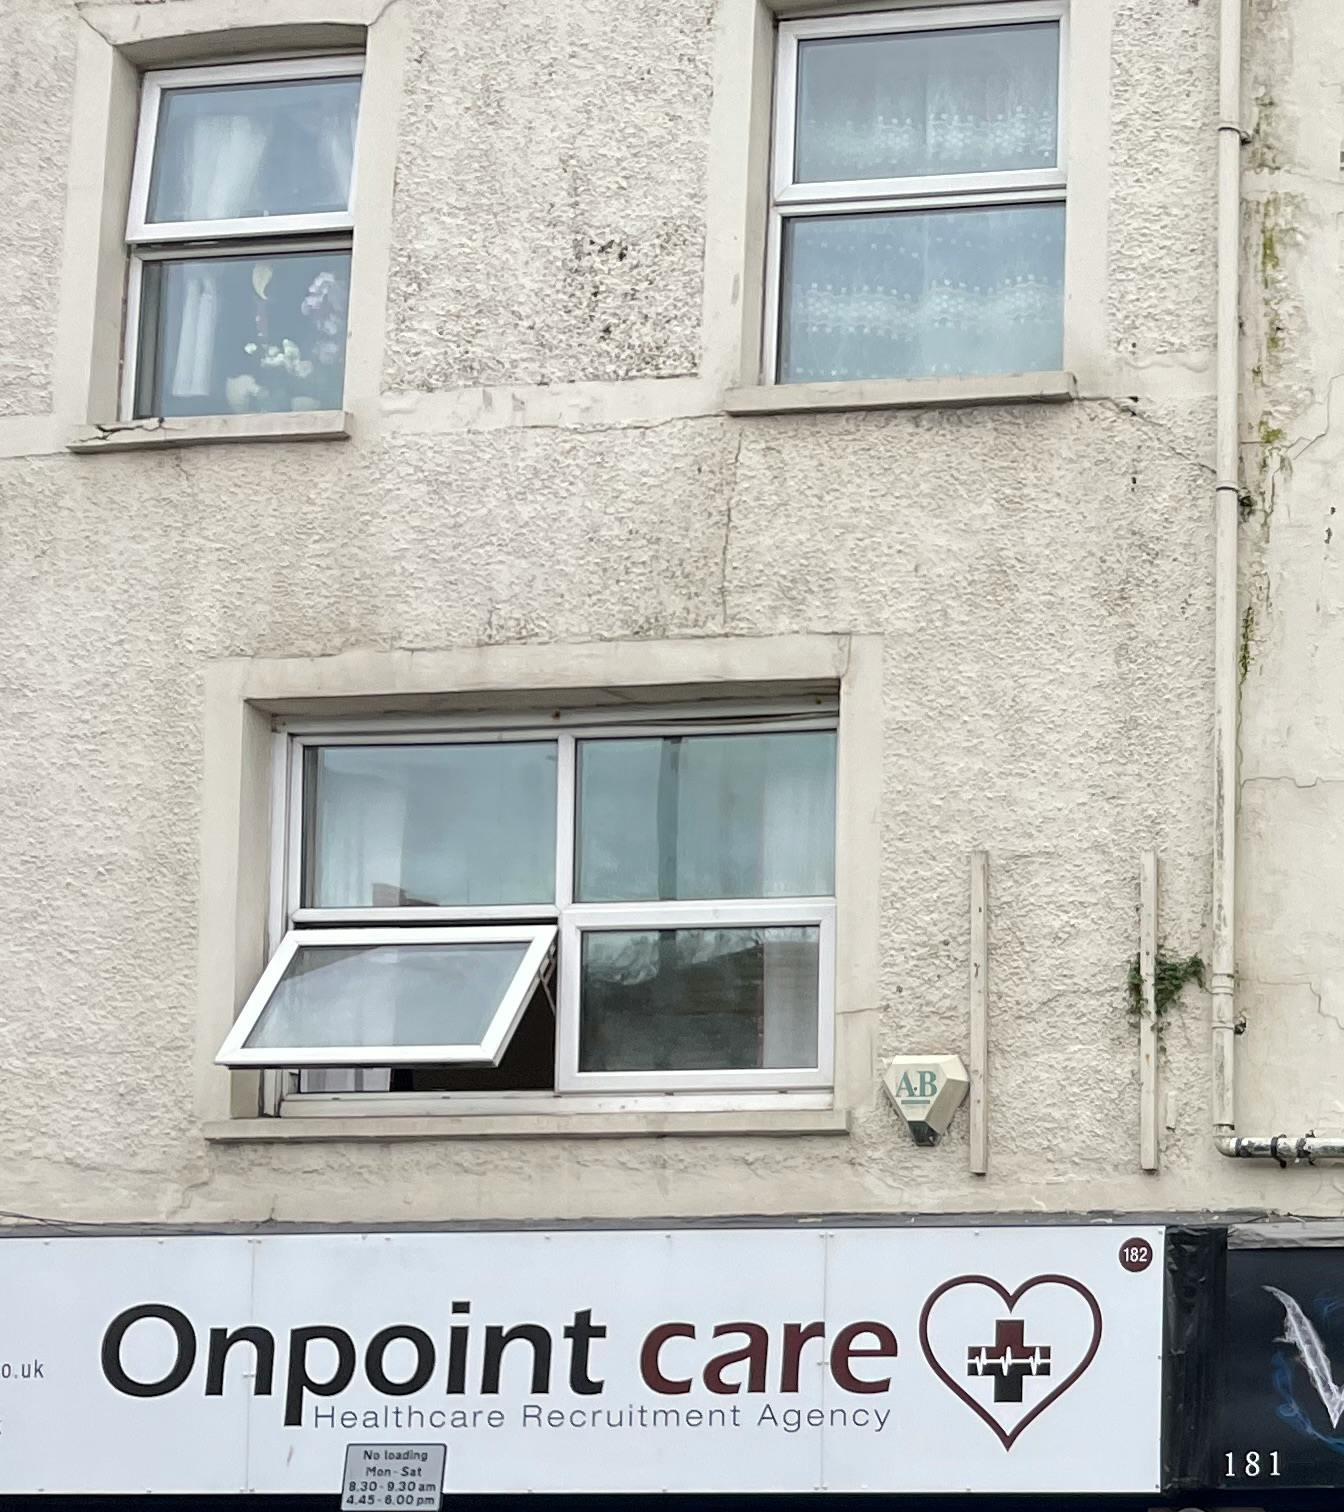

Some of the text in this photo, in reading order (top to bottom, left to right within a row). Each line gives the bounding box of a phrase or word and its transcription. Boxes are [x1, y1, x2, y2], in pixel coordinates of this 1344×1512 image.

[1122, 1246, 1148, 1263] 182
[101, 1301, 898, 1426] Onpoint care
[313, 1402, 892, 1433] Healthcare Recruitment Agency
[363, 1450, 428, 1462] No loading
[366, 1466, 422, 1477] Mon Sat
[1224, 1451, 1282, 1477] 181
[387, 1481, 416, 1492] 9.30
[418, 1483, 437, 1492] am
[346, 1494, 375, 1505] 4.45
[416, 1496, 435, 1507] pm
